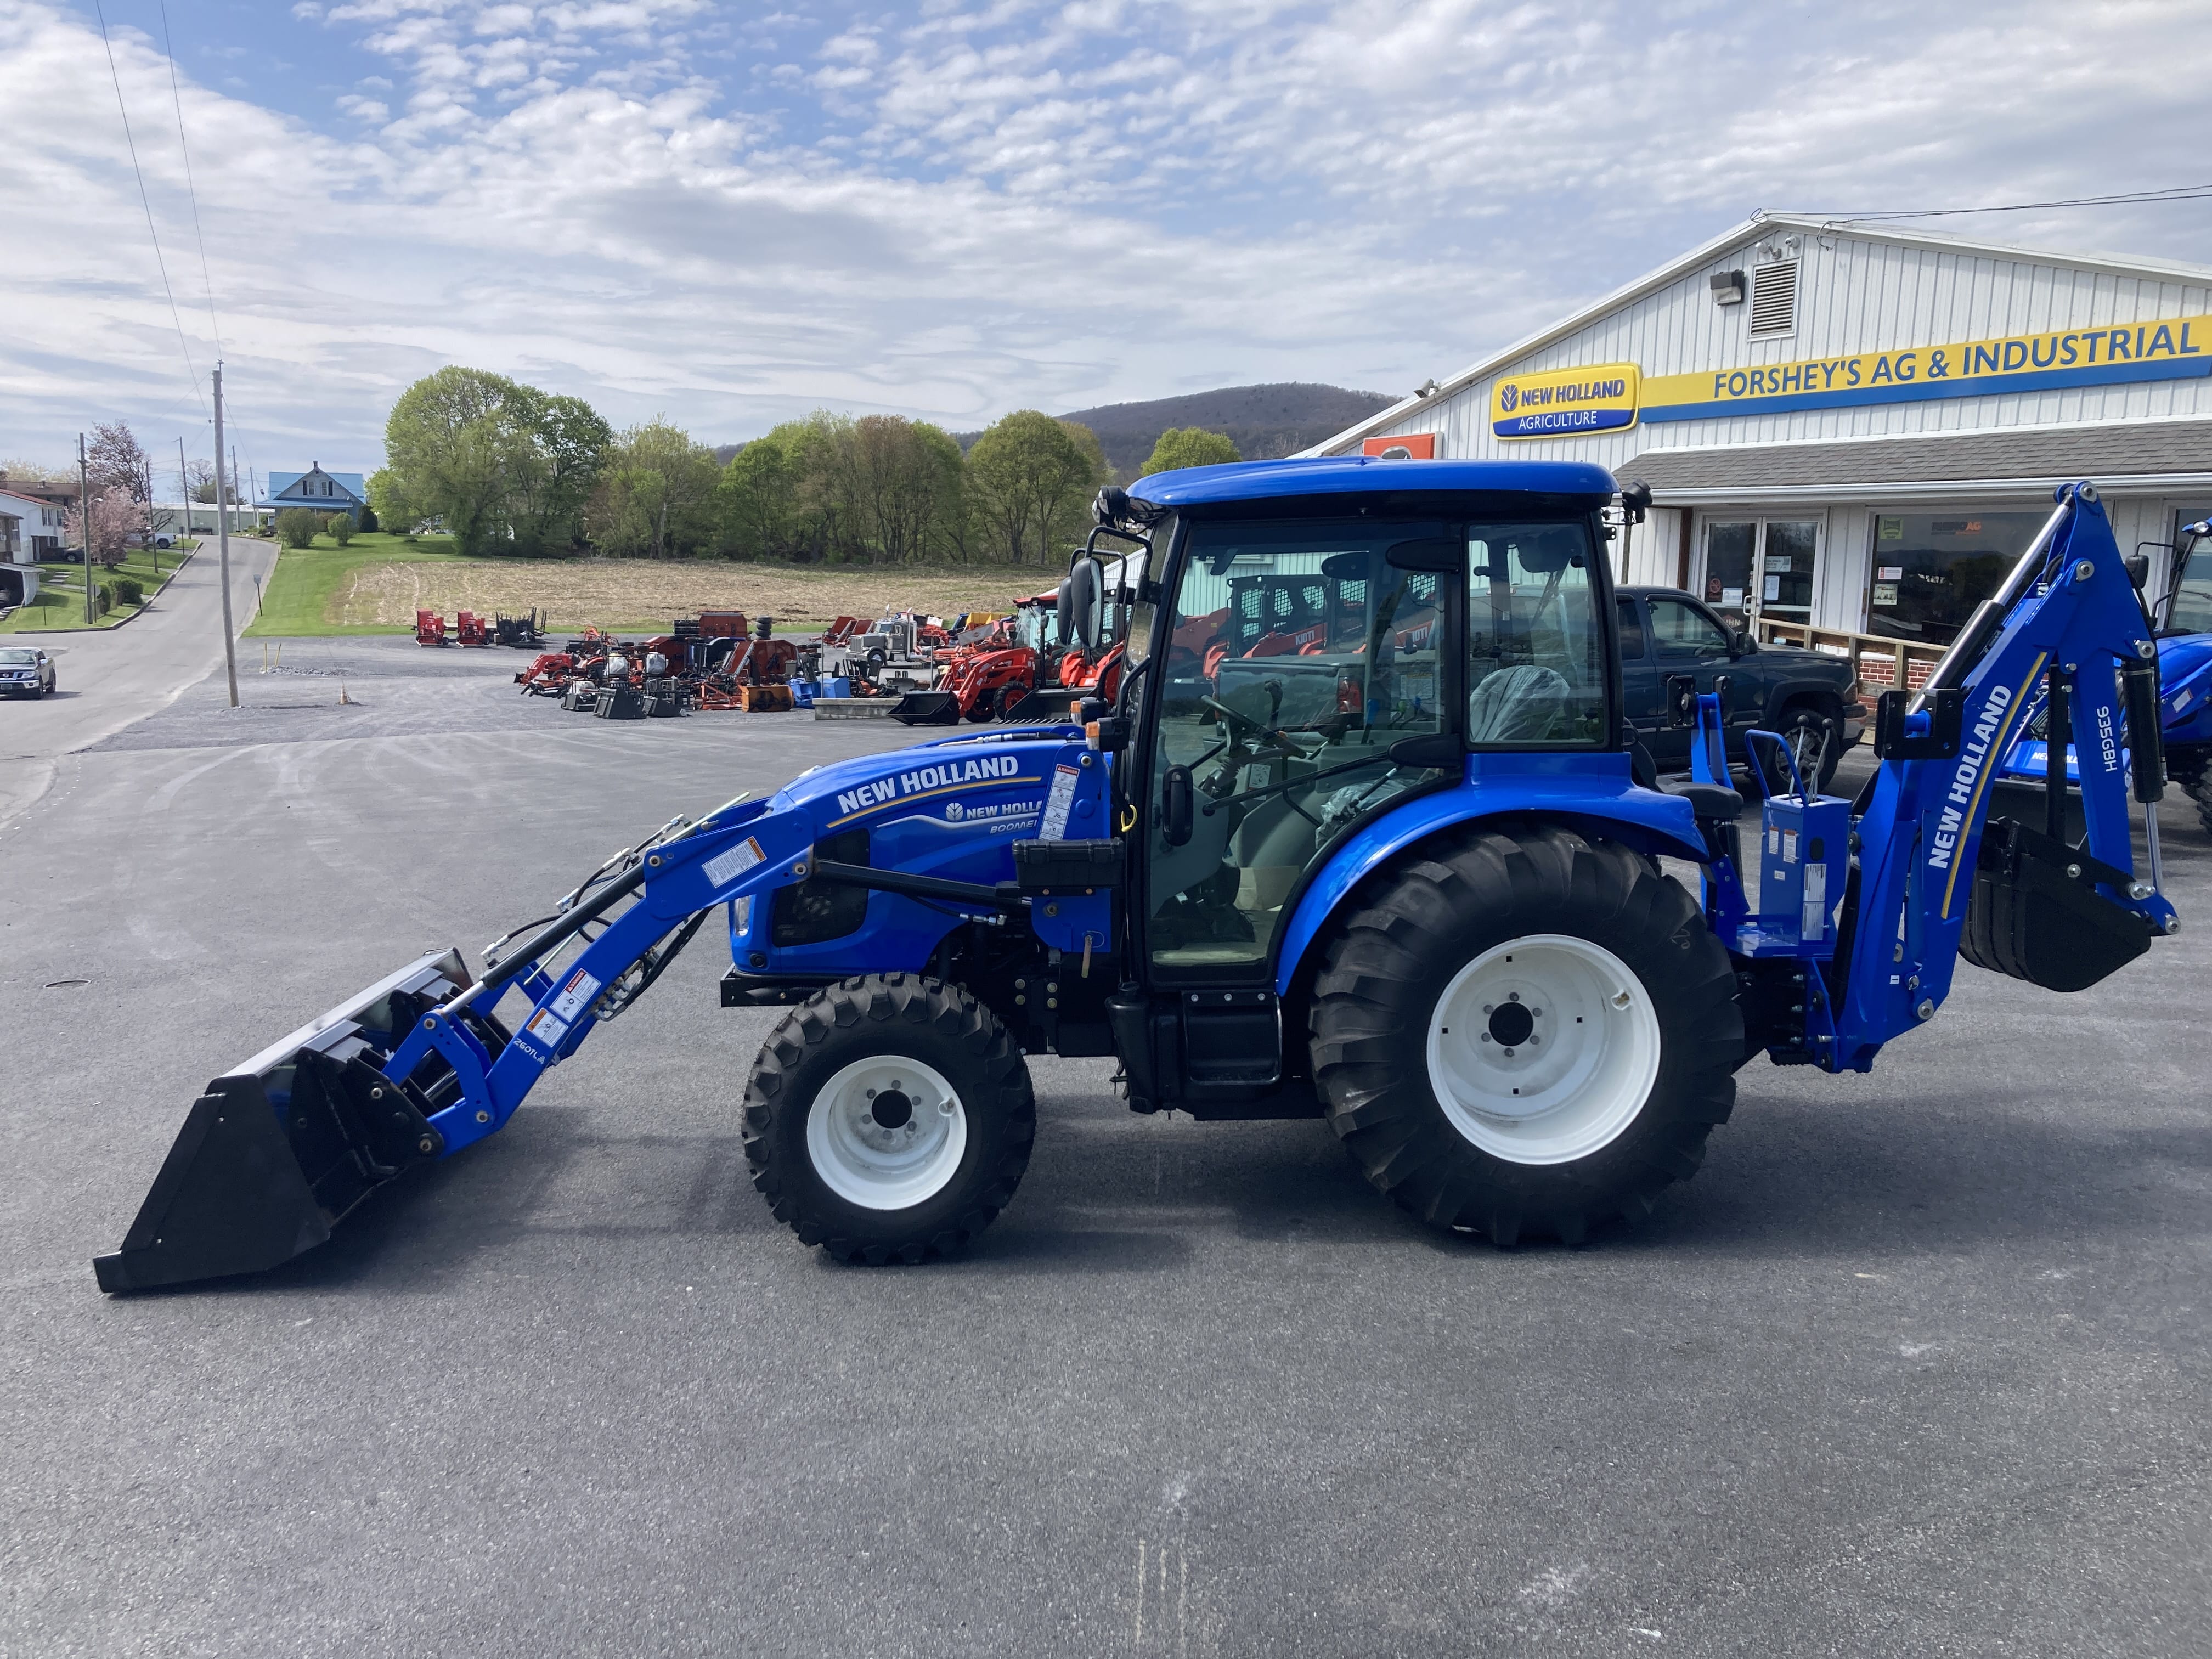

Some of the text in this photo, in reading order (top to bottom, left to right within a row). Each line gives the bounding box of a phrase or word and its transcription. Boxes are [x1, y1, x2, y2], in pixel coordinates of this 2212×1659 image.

[1714, 322, 2202, 398] FORSHEY'S AG & INDUSTRIAL
[1521, 379, 1625, 406] NEW HOLLAND
[1518, 410, 1598, 431] AGRICULTURE
[1295, 630, 1314, 645] KIOTI
[1413, 627, 1427, 642] IOTI
[2096, 706, 2118, 772] 935GBH
[837, 755, 1018, 814] NEW HOLLAND
[1928, 685, 2012, 869] NEW HOLLAND
[967, 800, 1042, 820] NEW HOLLA
[514, 1038, 546, 1065] 260TLA
